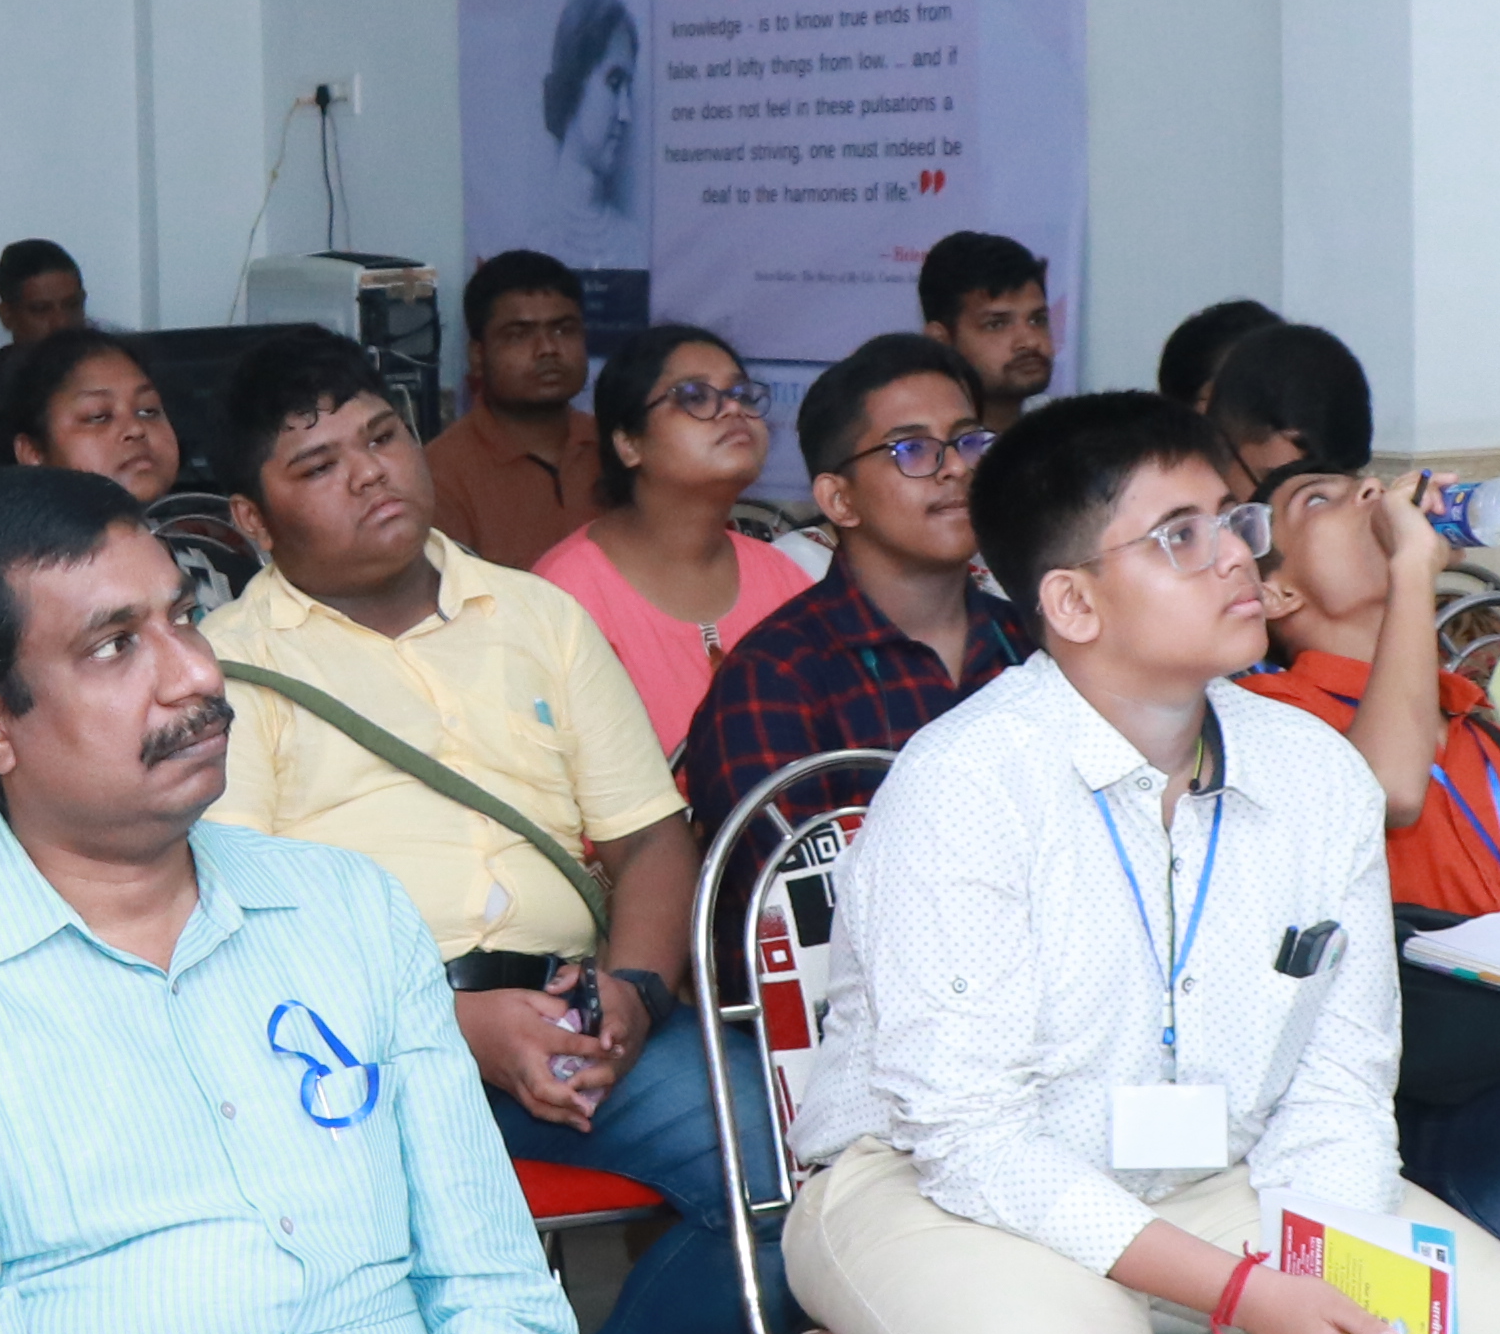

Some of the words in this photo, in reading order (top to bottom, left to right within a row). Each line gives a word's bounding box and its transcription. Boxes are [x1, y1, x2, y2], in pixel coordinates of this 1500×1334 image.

[671, 19, 742, 40] knowledge
[758, 16, 771, 33] is
[776, 14, 789, 32] to
[795, 12, 834, 31] know
[839, 10, 868, 28] true
[875, 7, 911, 26] ends
[916, 4, 951, 22] from
[707, 59, 732, 78] and
[737, 57, 765, 81] lofty
[771, 55, 814, 78] things
[819, 52, 853, 72] from
[913, 47, 942, 68] and
[947, 45, 958, 65] if
[671, 105, 696, 121] one
[701, 102, 733, 120] does
[738, 102, 760, 119] not
[766, 99, 791, 117] feel
[797, 99, 810, 116] in
[815, 97, 855, 115] these
[861, 95, 937, 118] pulsations
[943, 97, 954, 111] a
[664, 144, 745, 163] heavenward
[810, 144, 836, 160] one
[842, 142, 878, 159] must
[884, 139, 936, 158] indeed
[943, 138, 963, 157] be
[703, 185, 732, 204] deaf
[737, 186, 750, 203] to
[756, 185, 779, 203] the
[783, 183, 858, 203] harmonies
[864, 182, 880, 202] of
